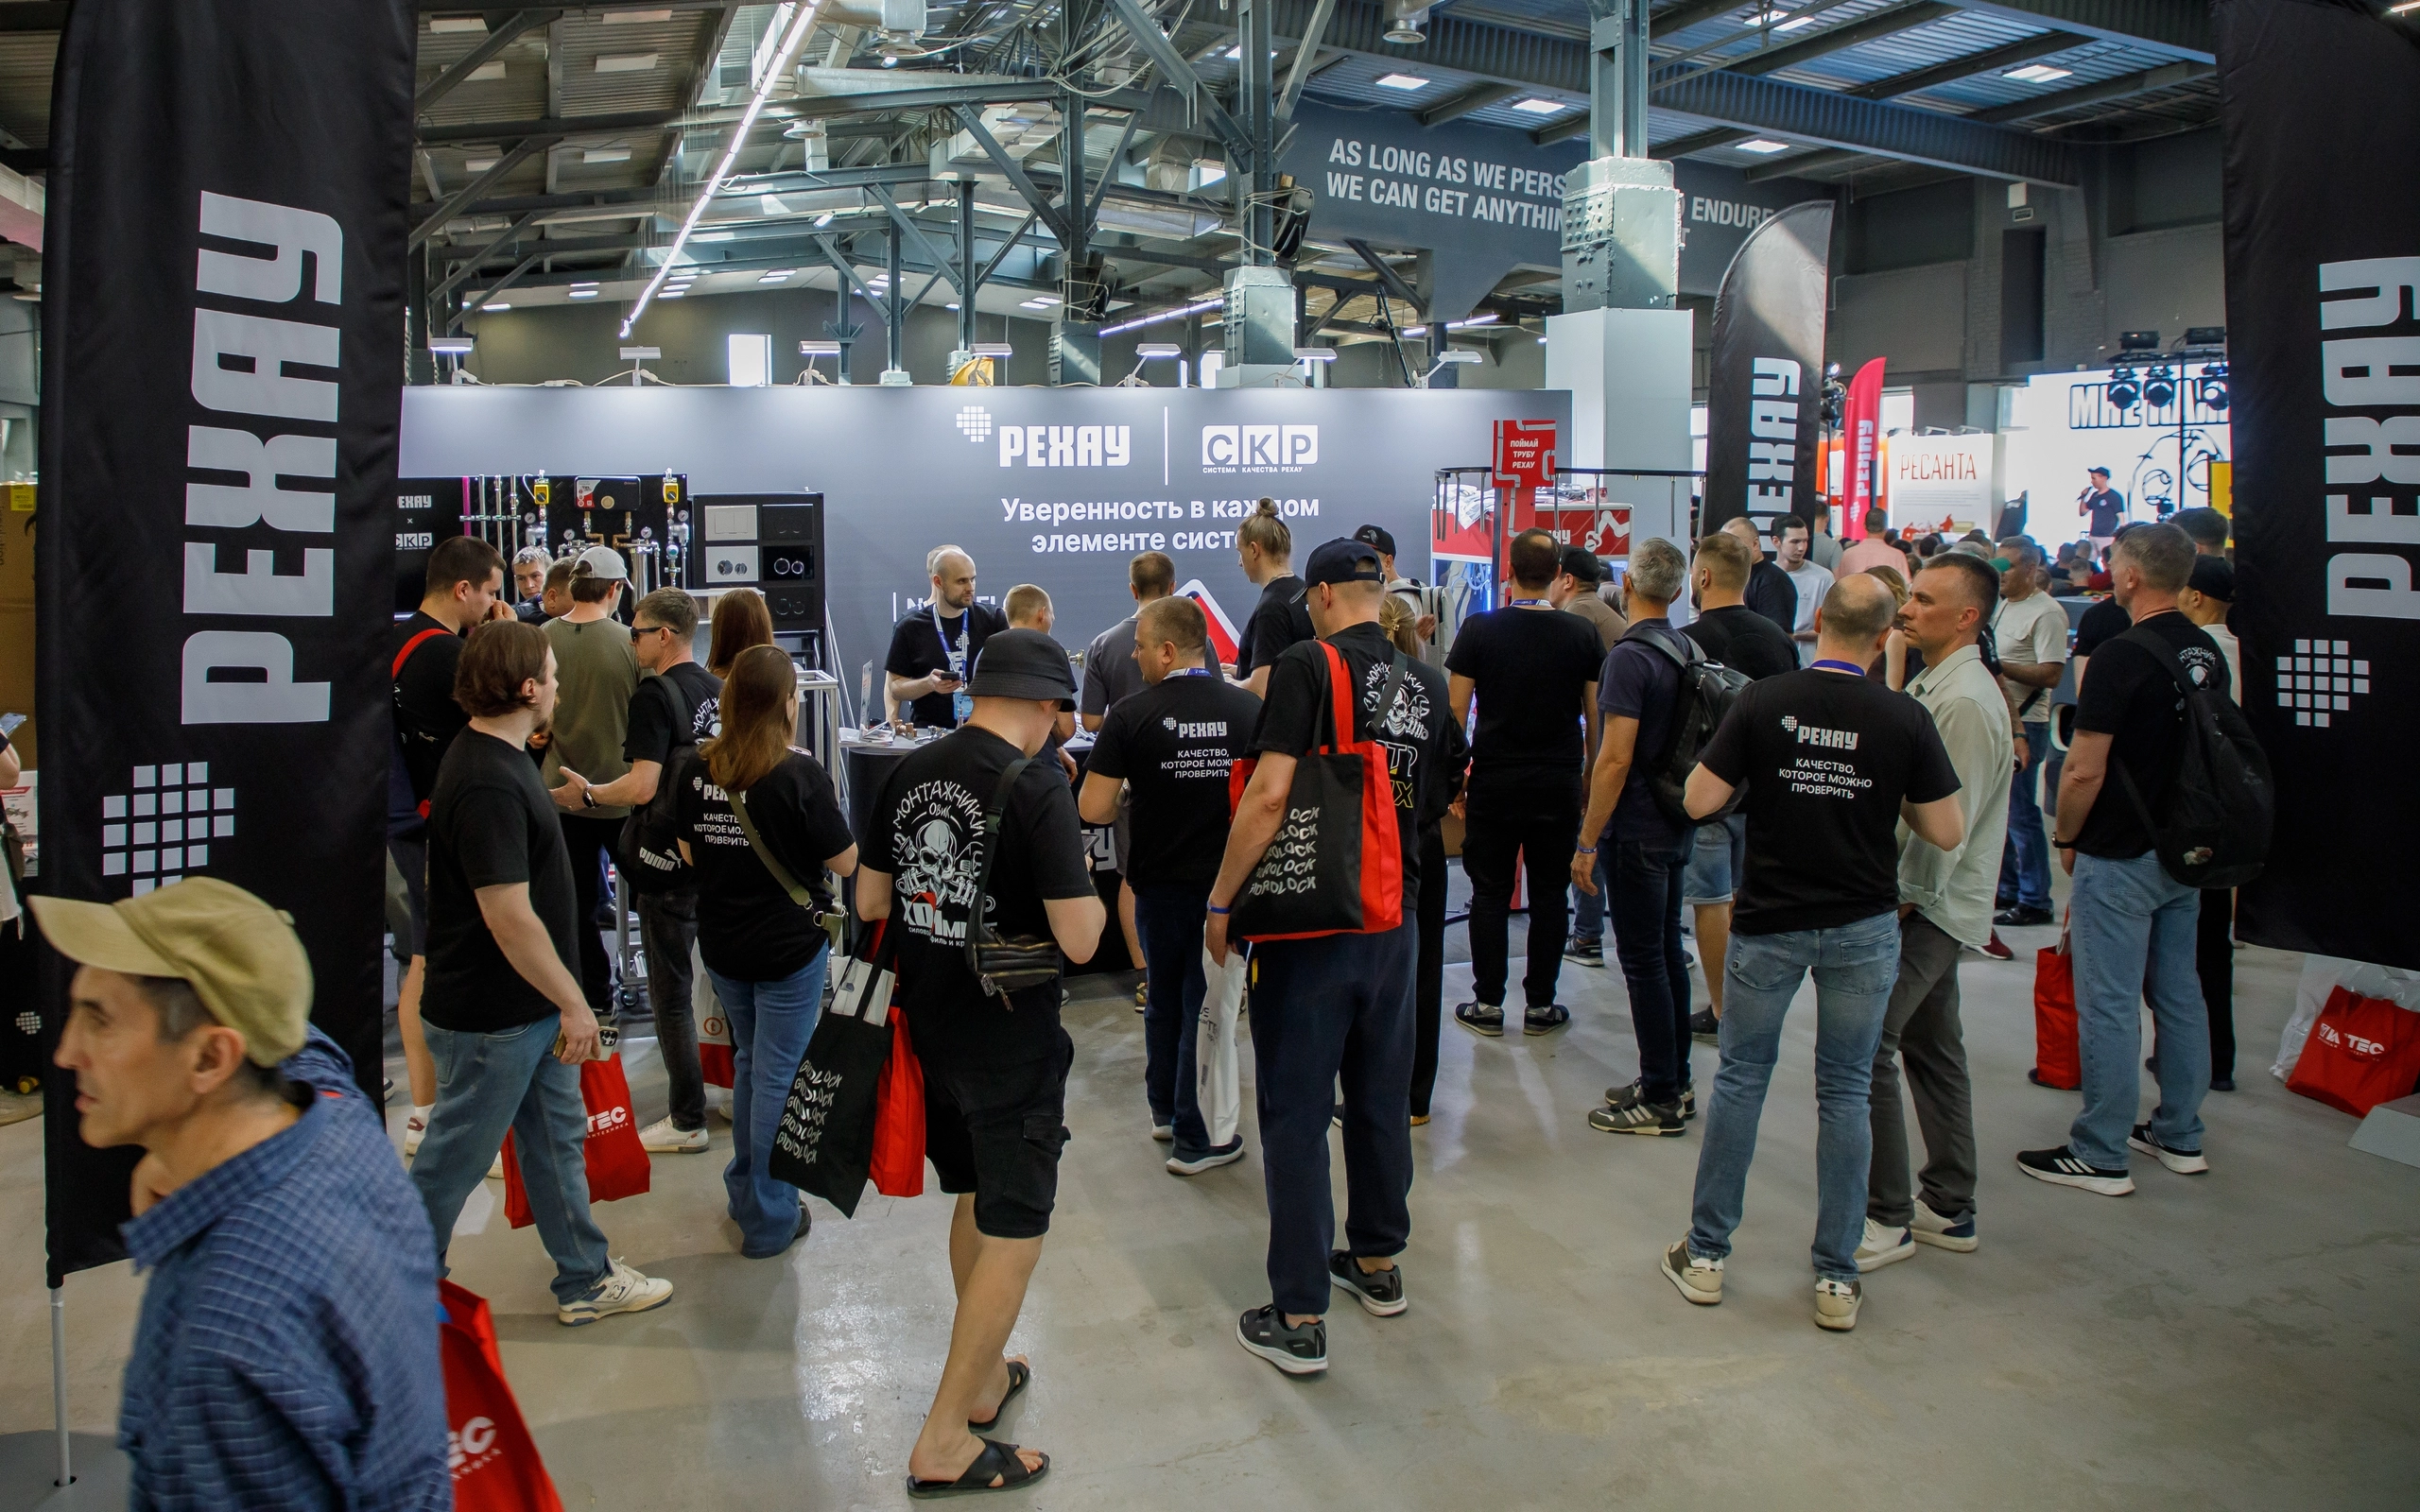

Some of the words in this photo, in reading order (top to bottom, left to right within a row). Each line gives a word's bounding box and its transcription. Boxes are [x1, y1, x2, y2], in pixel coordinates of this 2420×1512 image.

[1328, 138, 1362, 166] AS
[1369, 144, 1431, 178] LONG
[1435, 155, 1467, 183] AS
[1473, 161, 1506, 190] WE
[1510, 167, 1567, 199] PERS
[1326, 171, 1363, 200] WE
[1371, 178, 1418, 209] CAN
[1425, 186, 1469, 216] GET
[998, 425, 1131, 467] РЕХАУ
[1202, 424, 1318, 465] СКР
[1510, 438, 1539, 448] ПОЙМАЙ
[1512, 450, 1535, 458] ТРУБУ
[182, 190, 343, 725] РЕХАУ
[1856, 420, 1874, 497] РЕХАУ
[1899, 453, 1977, 480] РЕСАНТА
[397, 495, 432, 508] ЕХАУ
[1000, 497, 1184, 526] Уверенность
[1189, 501, 1205, 519] в
[1031, 532, 1166, 553] элементе
[1172, 530, 1240, 550] сист
[1178, 721, 1228, 738] РЕХАУ
[1797, 725, 1858, 750] РЕХАУ
[1161, 759, 1205, 769] КОТОРОЕ
[1177, 748, 1230, 759] КАЧЕСТВО,
[1175, 769, 1230, 779] ПРОВЕРИТЬ
[1779, 768, 1826, 782] КОТОРОЕ
[1828, 774, 1873, 788] МОЖНО
[1795, 758, 1856, 776] КАЧЕСТВО,
[1791, 782, 1855, 799] ПРОВЕРИТЬ
[639, 847, 676, 871] PUMA
